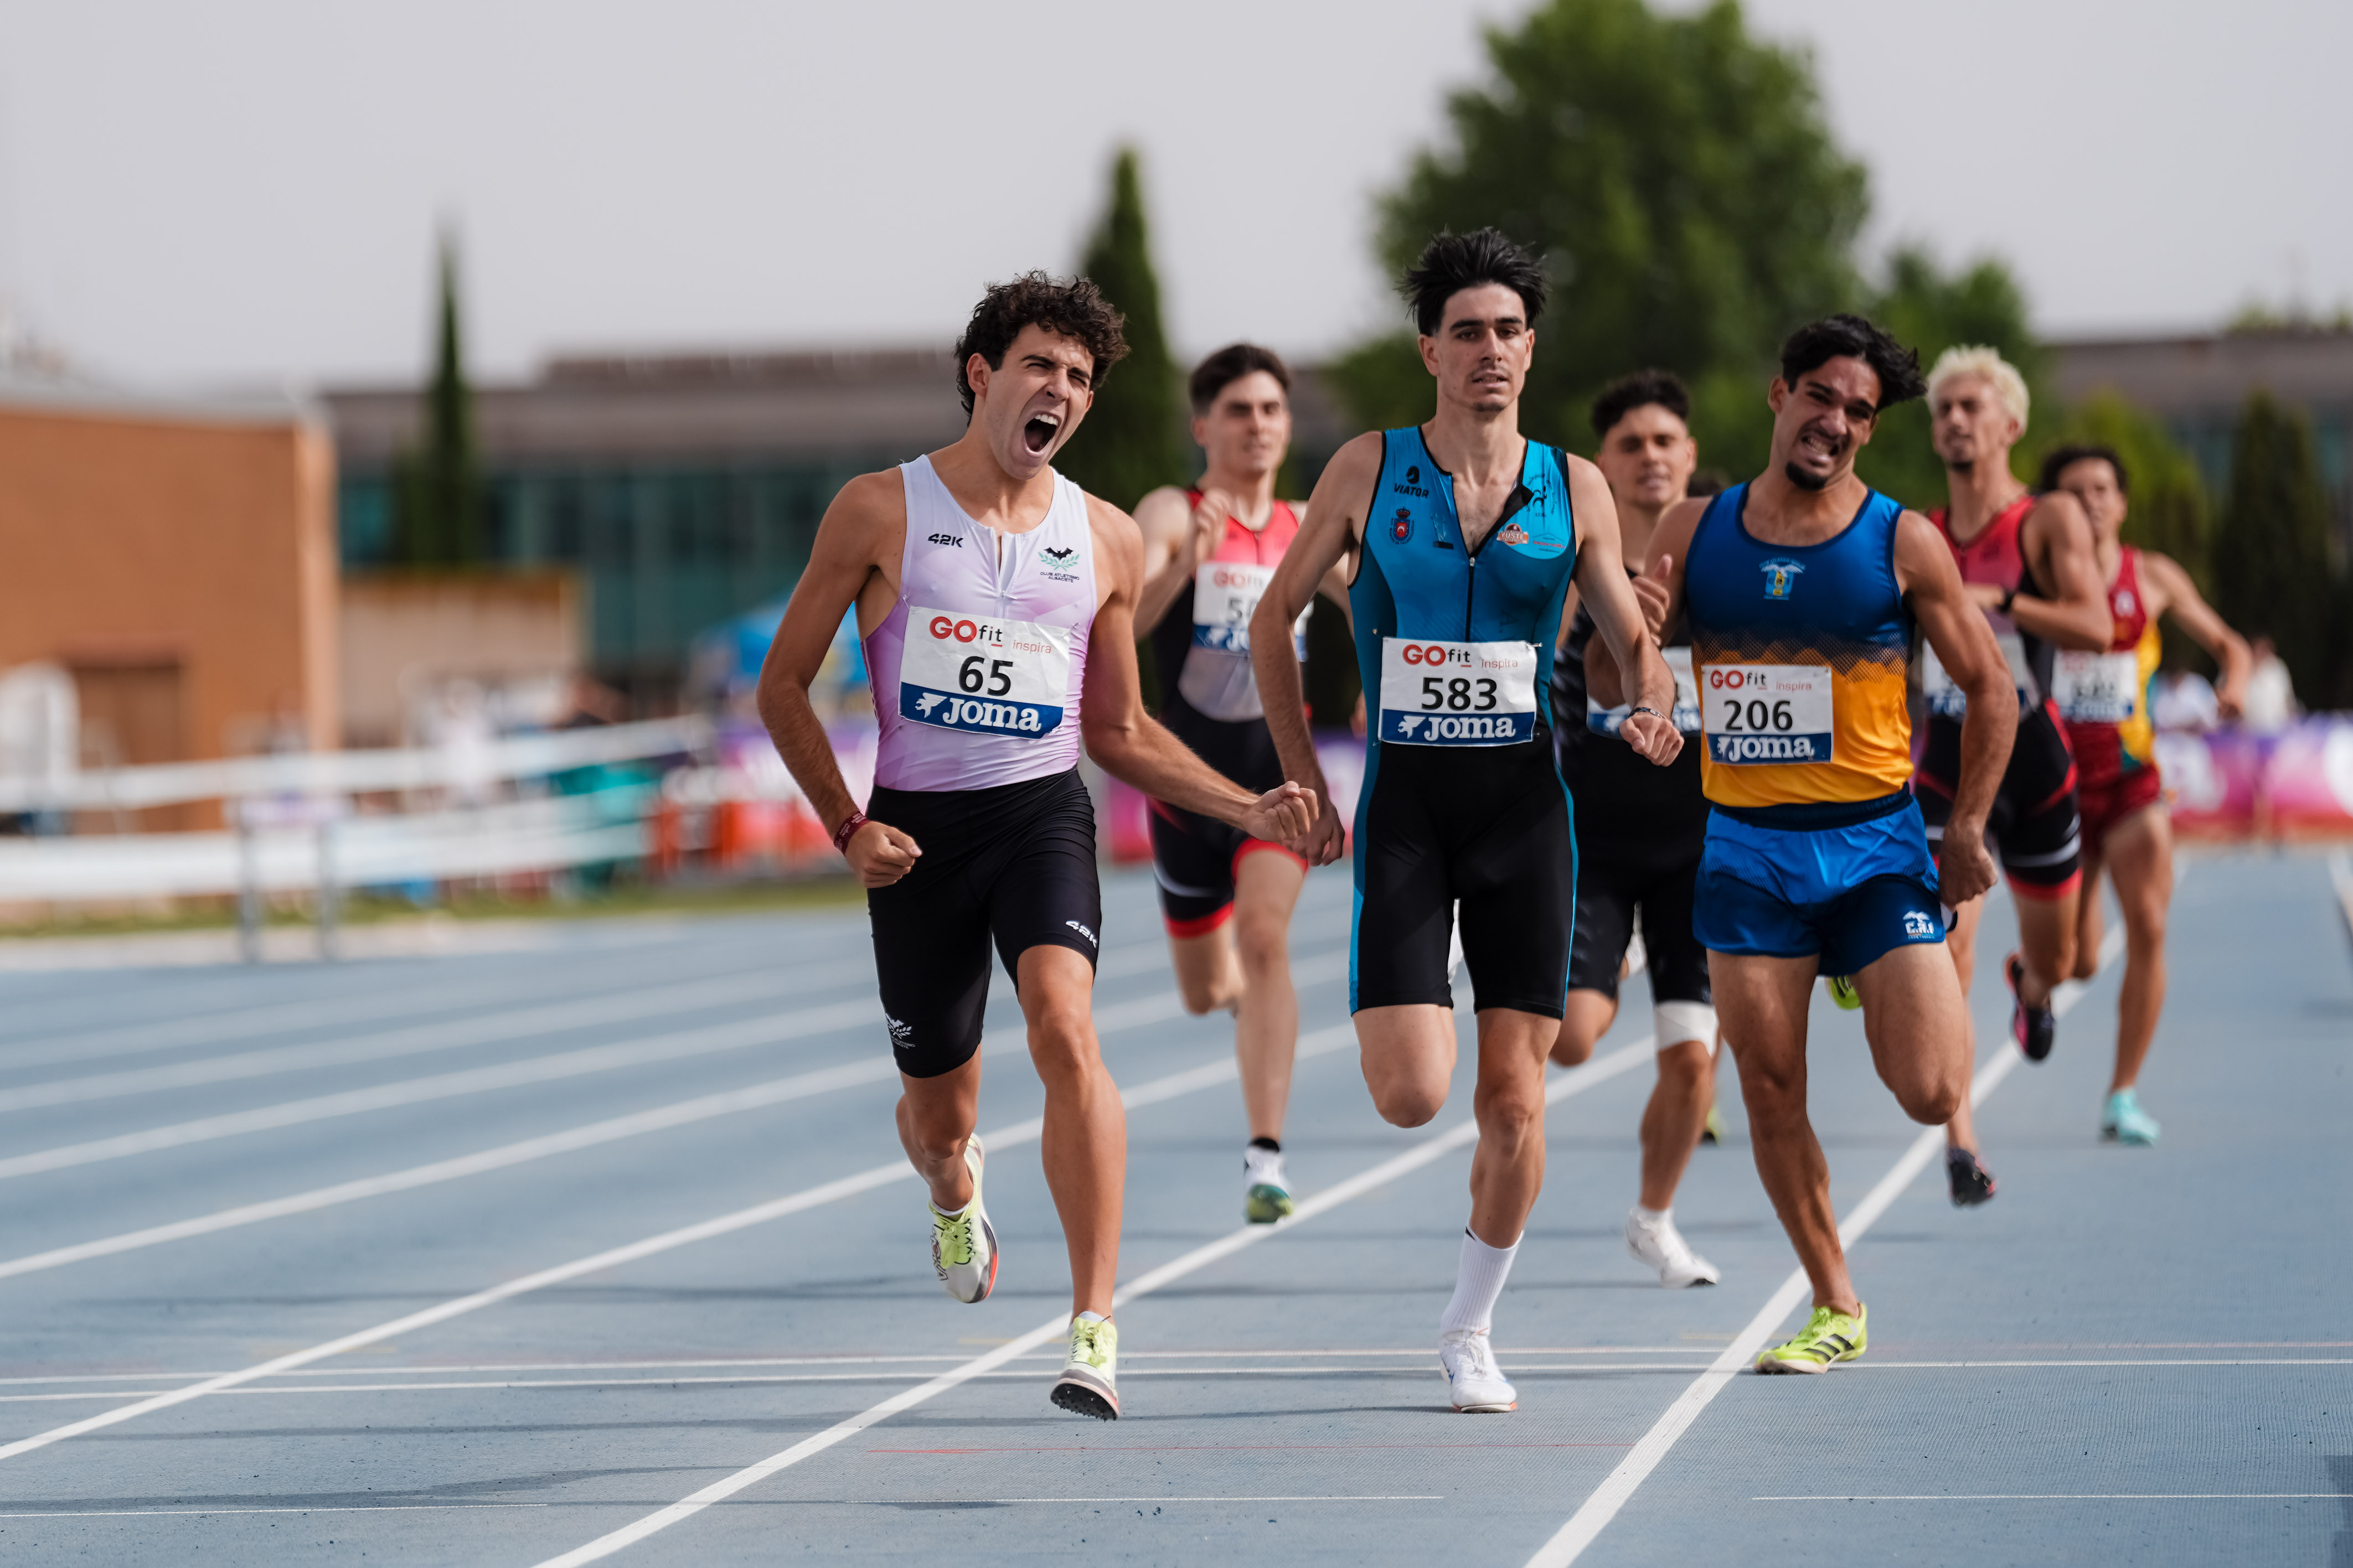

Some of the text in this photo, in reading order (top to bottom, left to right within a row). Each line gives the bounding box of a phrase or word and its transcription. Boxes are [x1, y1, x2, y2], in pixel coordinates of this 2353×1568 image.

[1394, 483, 1429, 499] VIATOR
[927, 533, 964, 548] 42K
[1501, 532, 1524, 540] YUSTE
[1013, 640, 1052, 654] inspira
[1481, 659, 1518, 670] inspira
[958, 656, 1014, 697] 65
[1421, 677, 1498, 711] 583
[1776, 681, 1812, 692] inspira
[1723, 700, 1793, 732] 206
[1065, 921, 1097, 949] 42K
